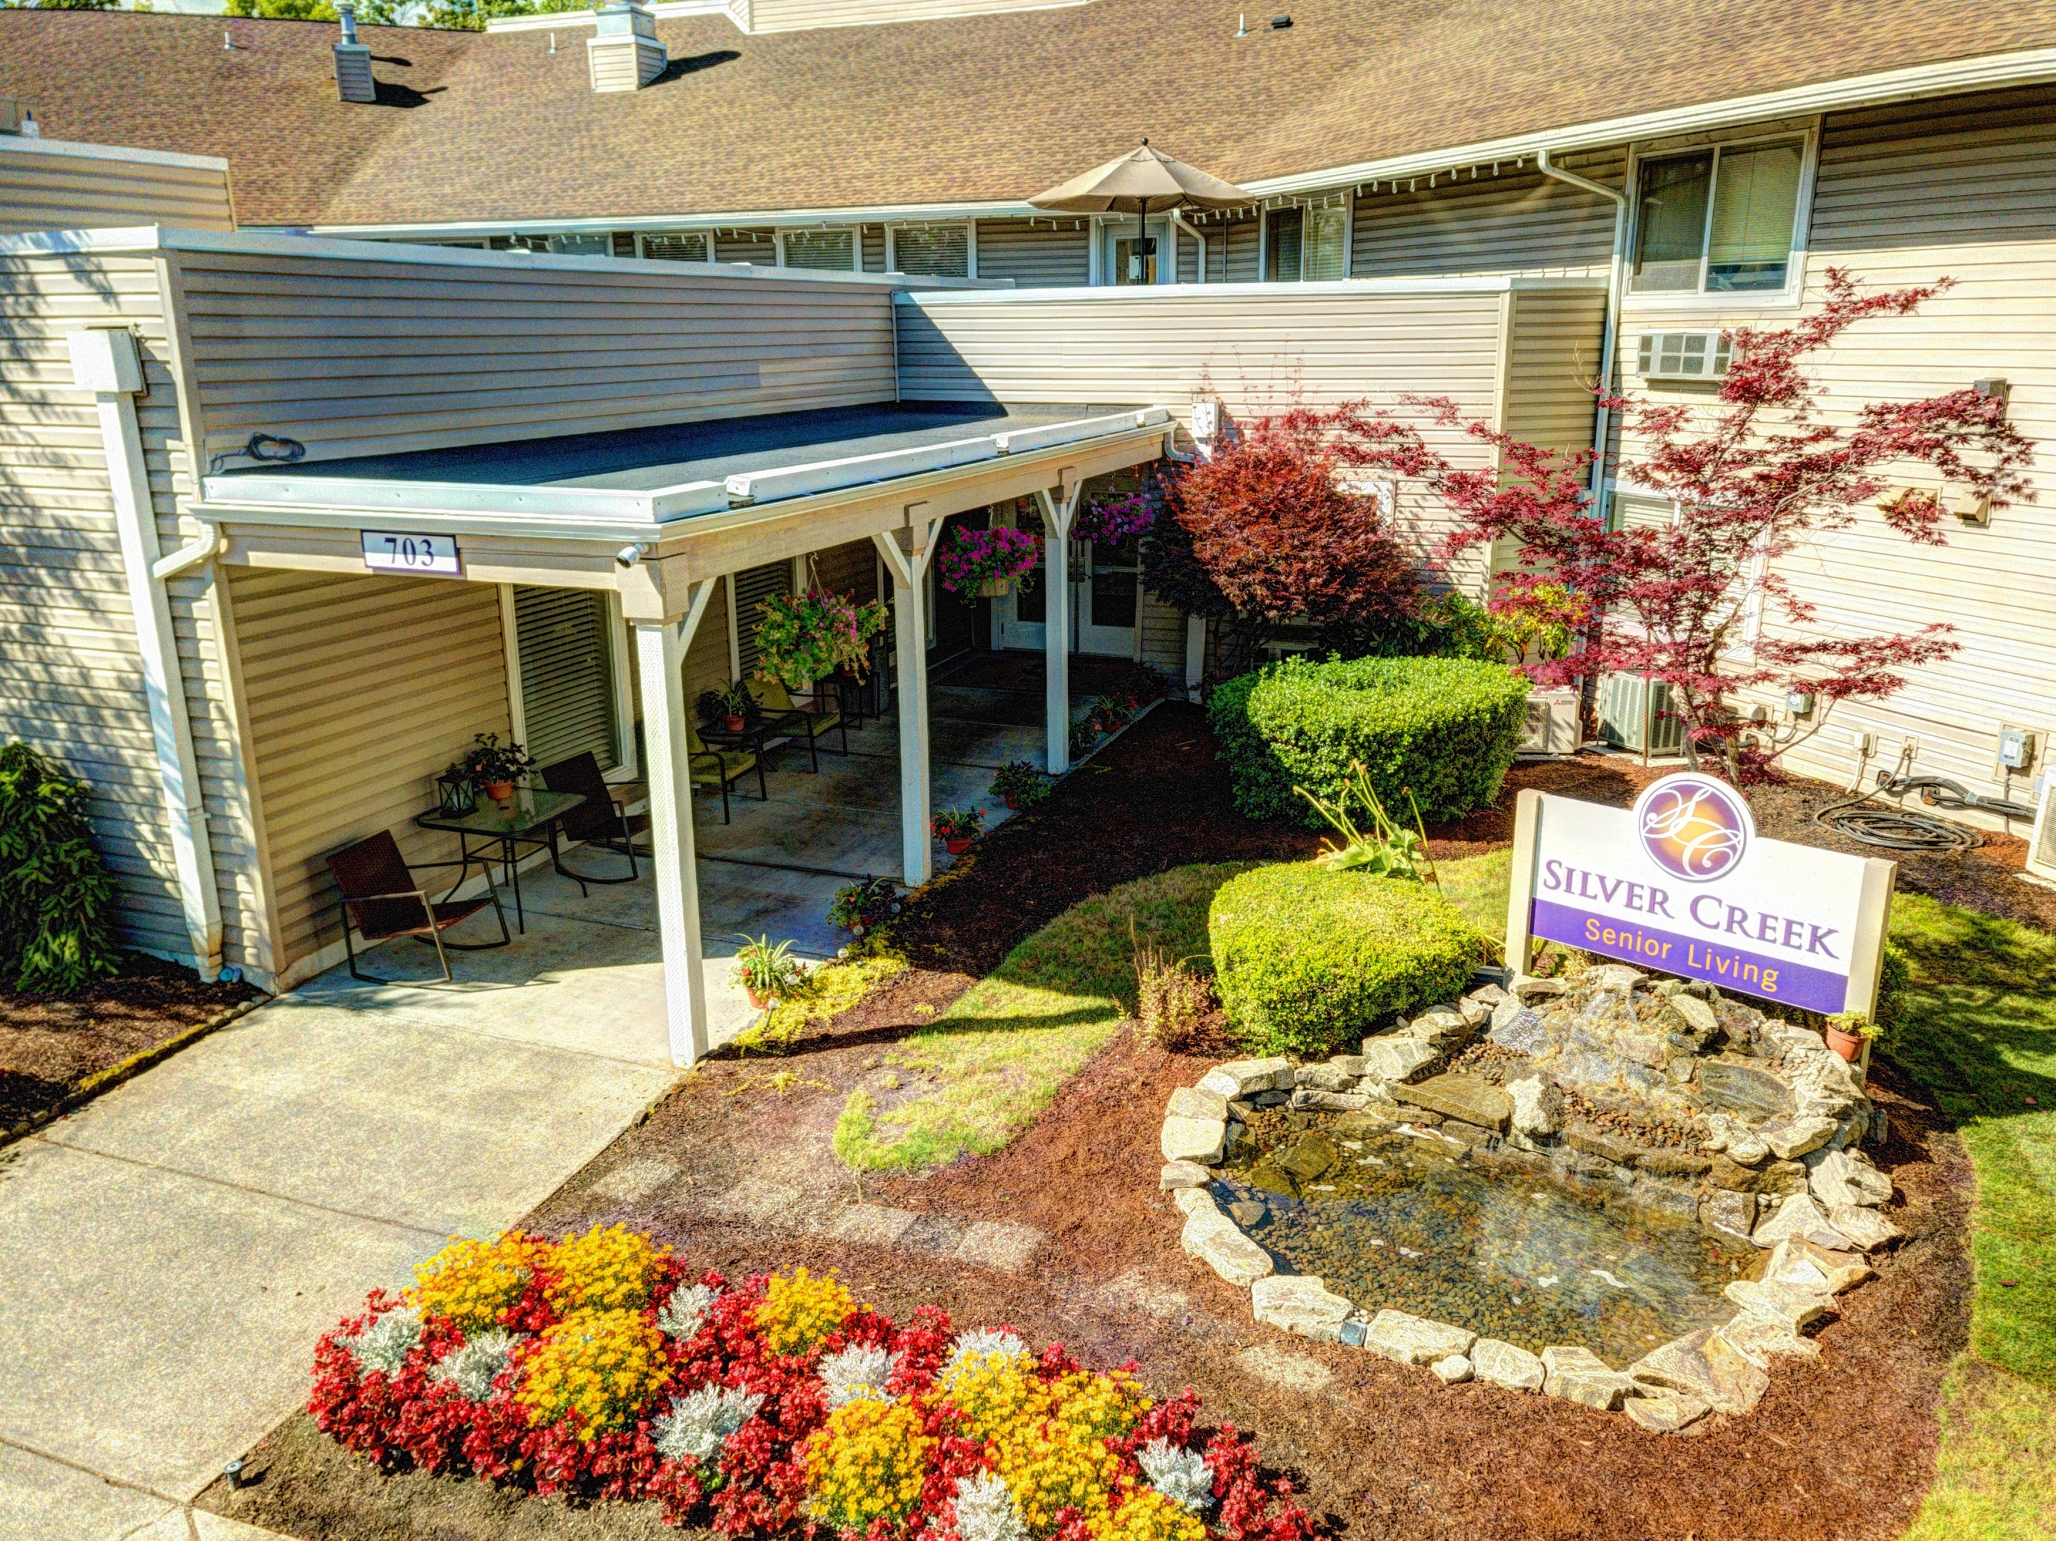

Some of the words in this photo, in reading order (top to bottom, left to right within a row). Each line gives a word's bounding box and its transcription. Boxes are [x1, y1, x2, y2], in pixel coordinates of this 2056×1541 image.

[384, 537, 434, 566] 703
[1543, 859, 1675, 919] SILVER
[1689, 894, 1840, 960] CREEK
[1585, 919, 1672, 959] Senior
[1688, 944, 1779, 992] Living
